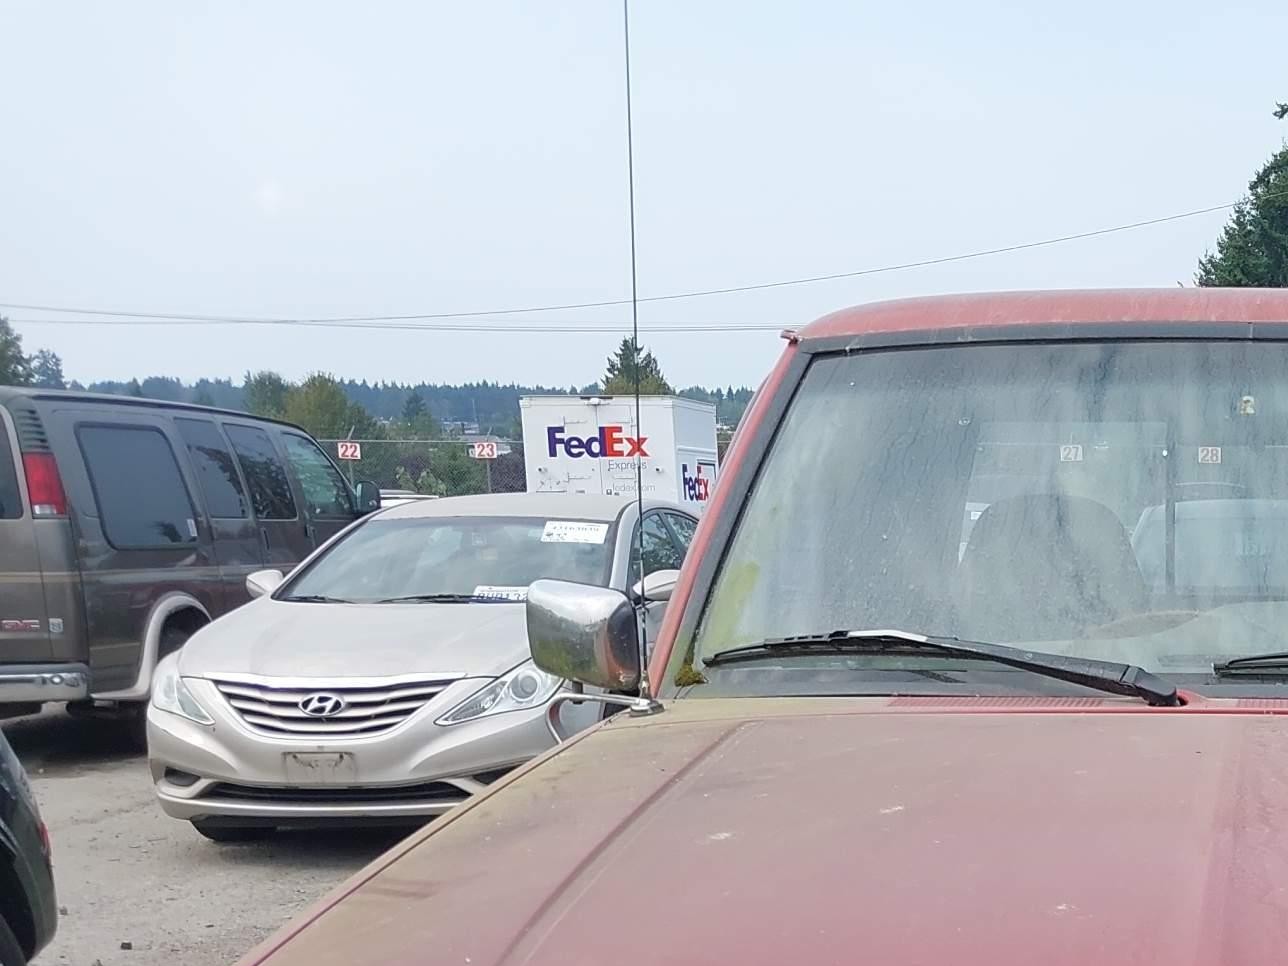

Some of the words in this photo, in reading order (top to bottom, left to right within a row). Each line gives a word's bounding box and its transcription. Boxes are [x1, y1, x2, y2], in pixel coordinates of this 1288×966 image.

[547, 426, 651, 458] FedEx
[340, 444, 358, 458] 22
[476, 443, 495, 458] 23
[1062, 446, 1082, 461] 27
[1200, 447, 1220, 462] 28
[608, 459, 648, 472] Expres
[681, 463, 711, 502] FedEx
